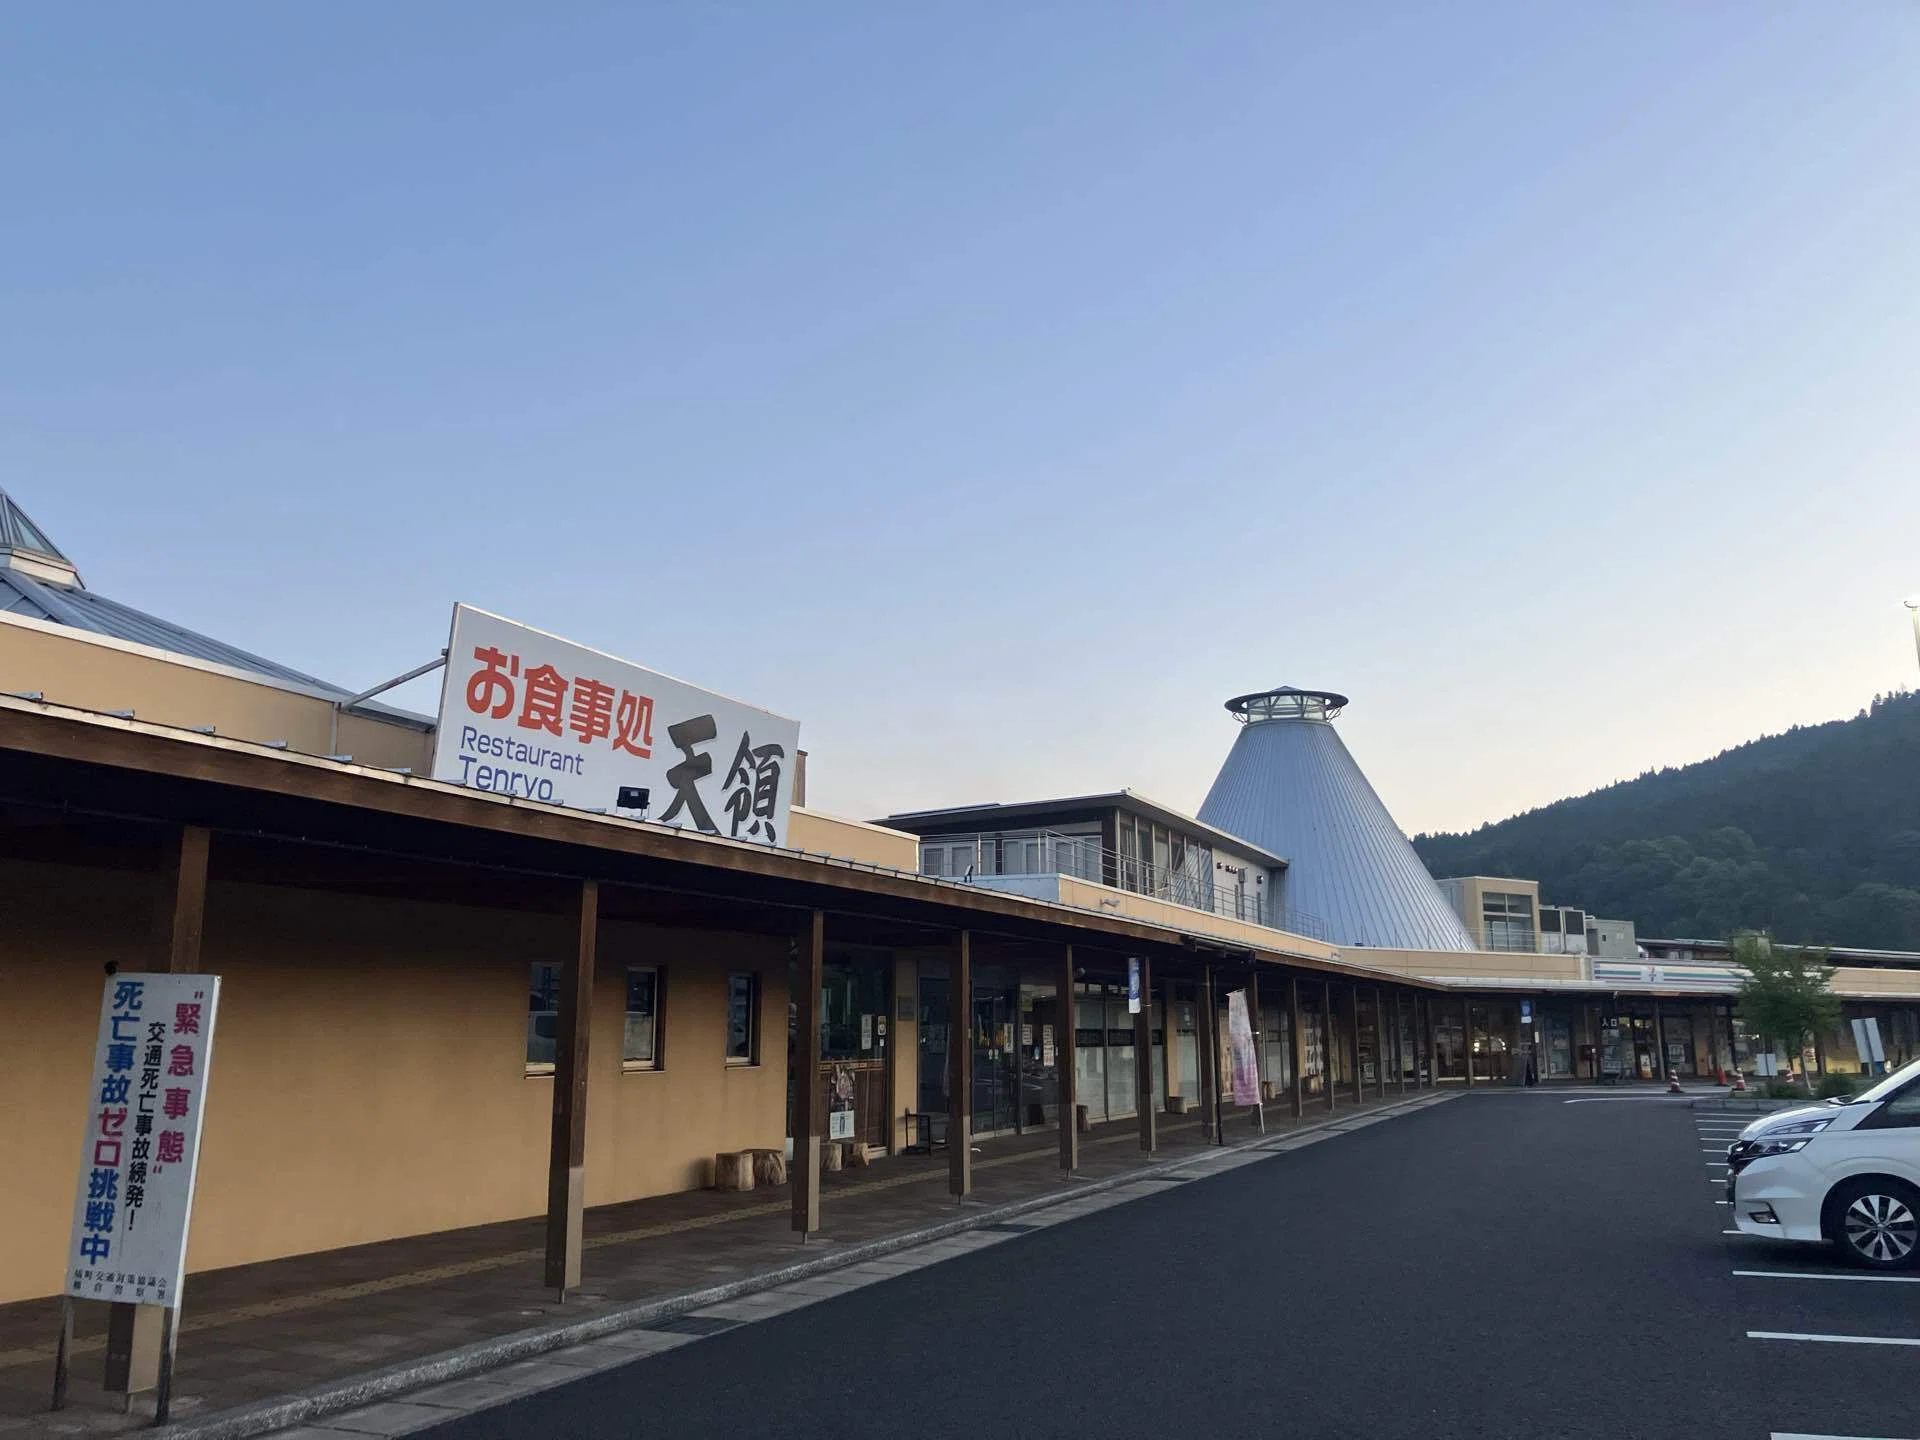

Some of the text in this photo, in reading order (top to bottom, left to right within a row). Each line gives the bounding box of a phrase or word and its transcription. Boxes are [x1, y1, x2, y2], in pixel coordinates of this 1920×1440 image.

[460, 725, 585, 775] Restaurant
[465, 646, 655, 760] お食事処
[458, 754, 554, 801] Tenryo
[657, 713, 785, 843] 天領
[80, 981, 144, 1266] 死亡事故ゼロ挑戦中
[125, 1021, 166, 1231] 交通死亡事故続発！
